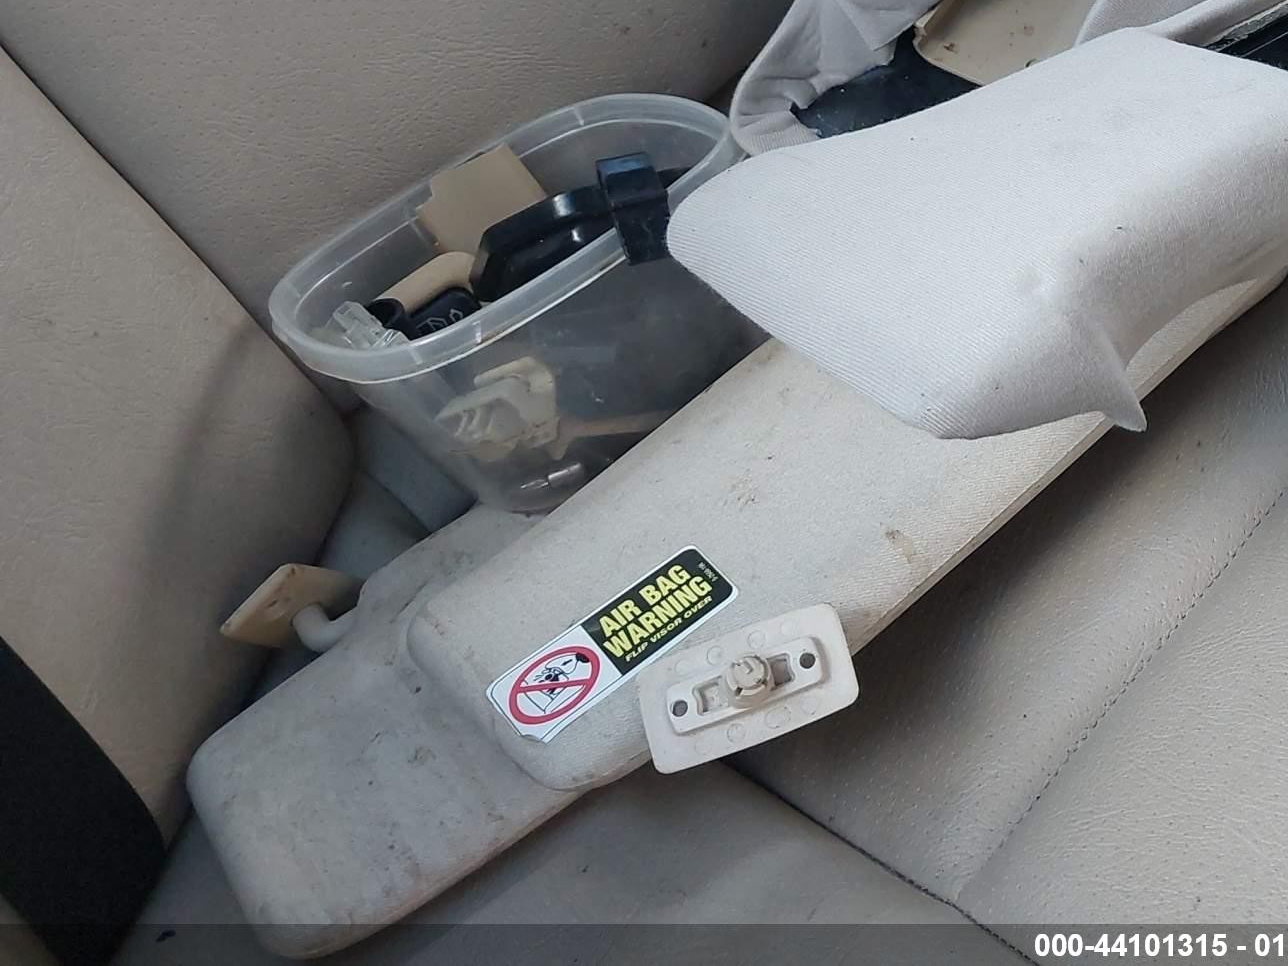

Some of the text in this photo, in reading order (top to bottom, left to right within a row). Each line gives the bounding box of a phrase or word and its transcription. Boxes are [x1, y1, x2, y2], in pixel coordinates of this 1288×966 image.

[599, 599, 643, 637] AIR
[638, 565, 691, 606] BAG
[602, 576, 713, 658] WARNING
[625, 595, 713, 662] FLIP VISOR OVER
